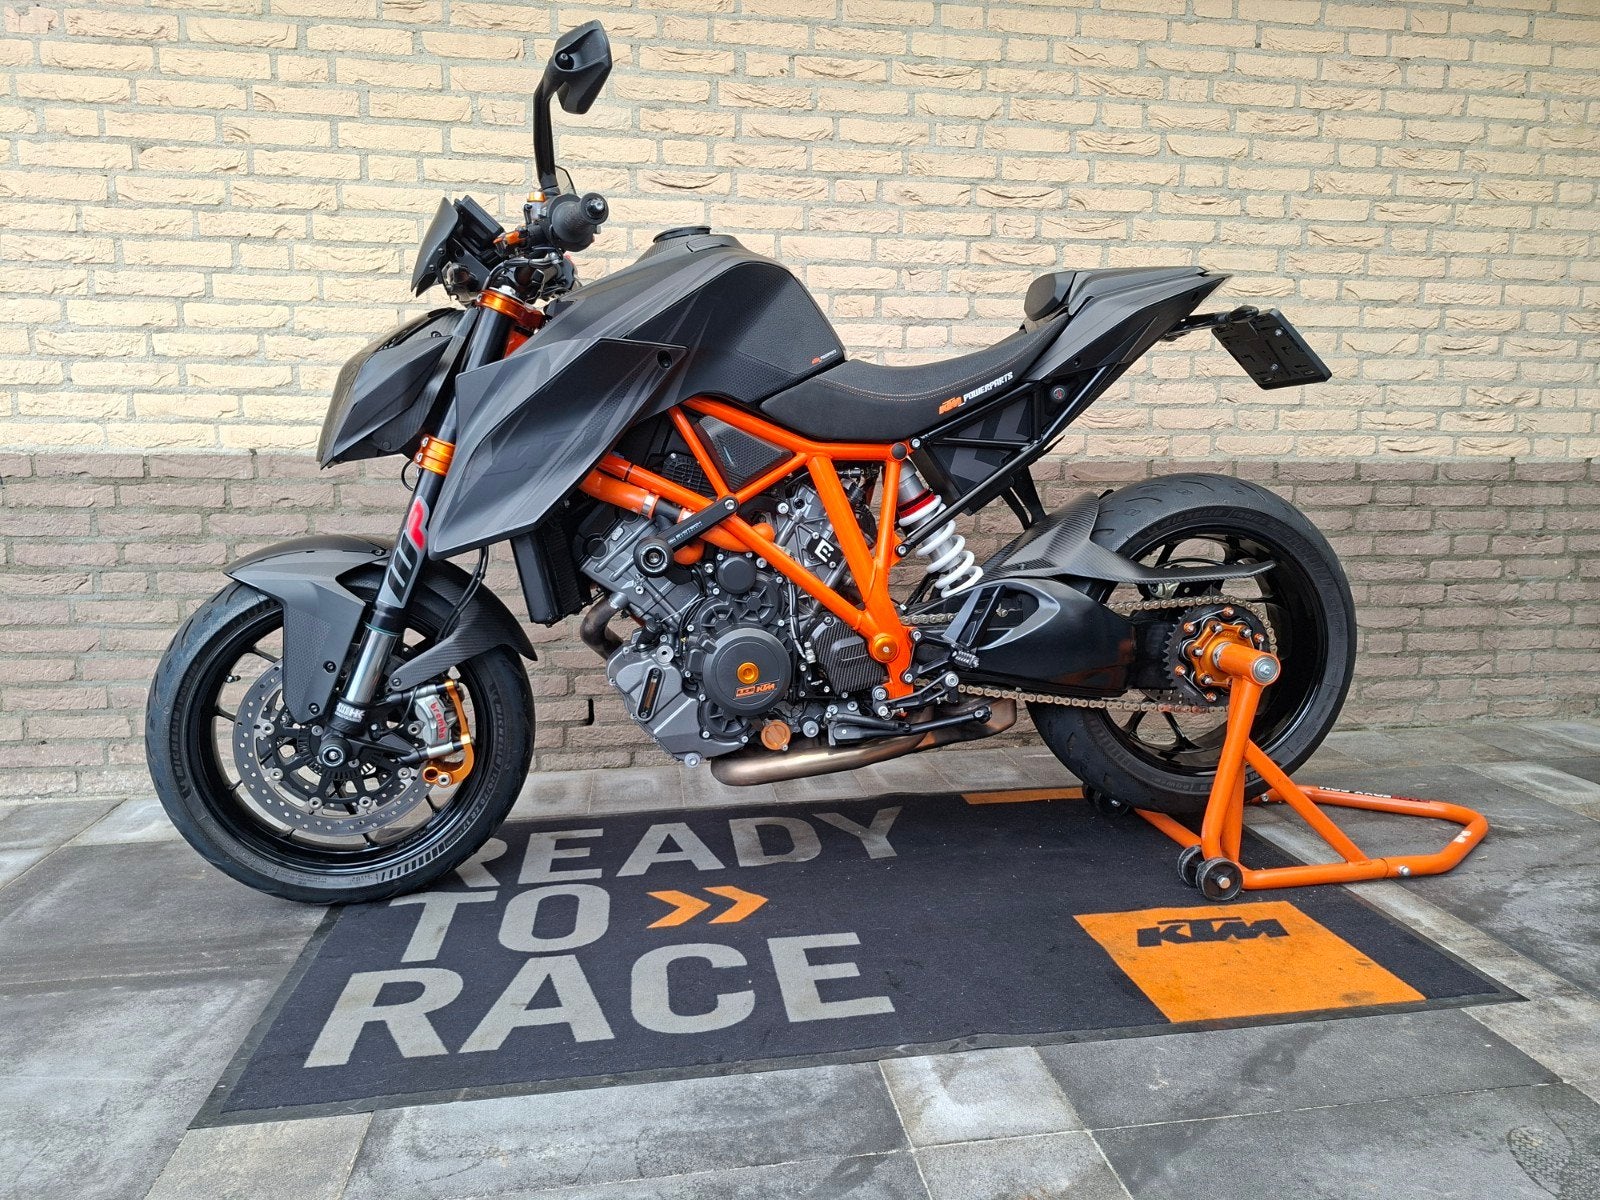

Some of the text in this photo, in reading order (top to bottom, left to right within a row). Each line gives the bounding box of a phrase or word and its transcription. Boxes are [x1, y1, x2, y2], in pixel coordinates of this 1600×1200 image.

[963, 371, 1014, 403] POWERPARTS
[430, 701, 447, 740] brembo
[389, 884, 611, 963] TO
[1137, 916, 1290, 948] KTM
[303, 932, 896, 1069] RACE
